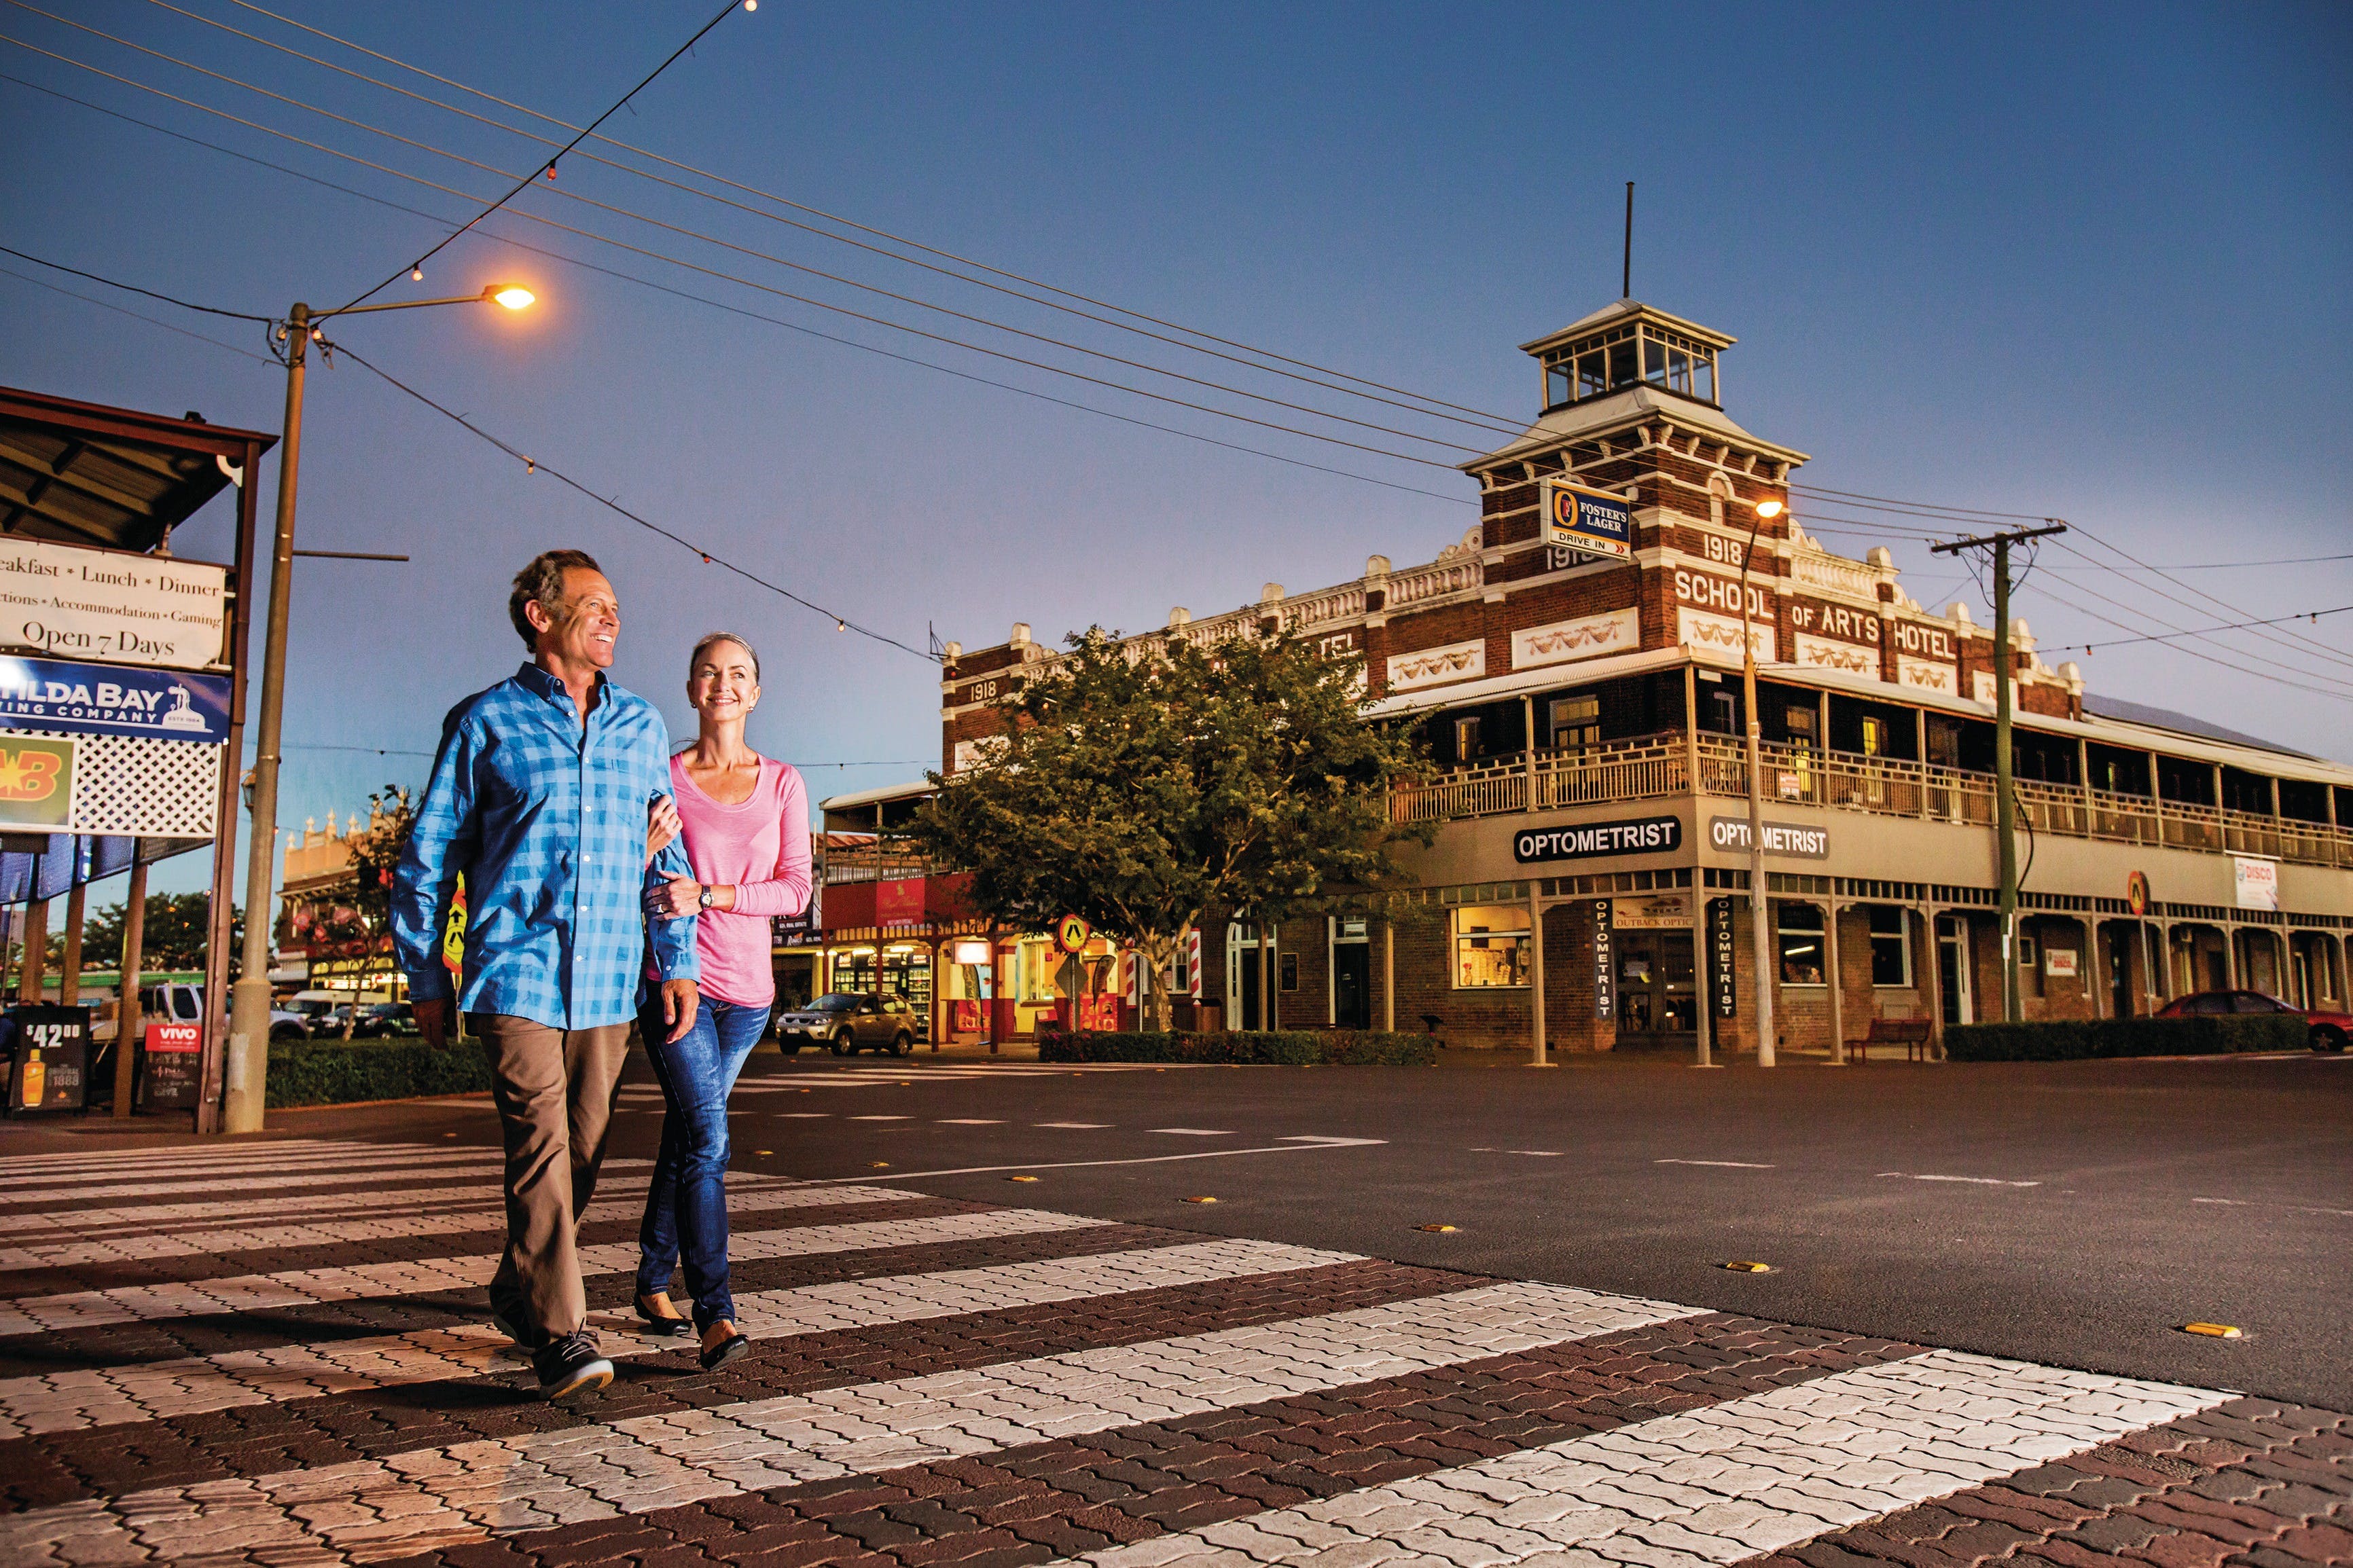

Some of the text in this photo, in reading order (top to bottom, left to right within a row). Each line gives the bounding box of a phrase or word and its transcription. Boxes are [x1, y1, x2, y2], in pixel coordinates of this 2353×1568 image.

[1580, 502, 1627, 523] FOSTER'S
[1586, 515, 1622, 532] LAGER
[1559, 532, 1605, 549] DRIVE IN
[1704, 534, 1742, 566] 1918
[82, 566, 137, 587] Lunch
[159, 576, 219, 597] Dinner
[50, 596, 160, 621] Accommodation
[170, 610, 221, 629] Gaming
[1674, 571, 1956, 659] SCHOOL OF ARTS HOTEL
[23, 621, 175, 661] Open 7 Days
[96, 682, 164, 712] BAY
[971, 680, 996, 701] 1918
[57, 705, 157, 724] COMPANY
[1519, 822, 1675, 857] OPTOMETRIST
[1713, 822, 1826, 854] OPTMETRIST
[2246, 866, 2271, 880] DISCO
[1616, 917, 1661, 927] OUTBACK
[1596, 901, 1610, 1016] OPTOMETRIST
[1717, 900, 1737, 1015] OPTOMETRIST
[160, 1027, 197, 1040] VIVO
